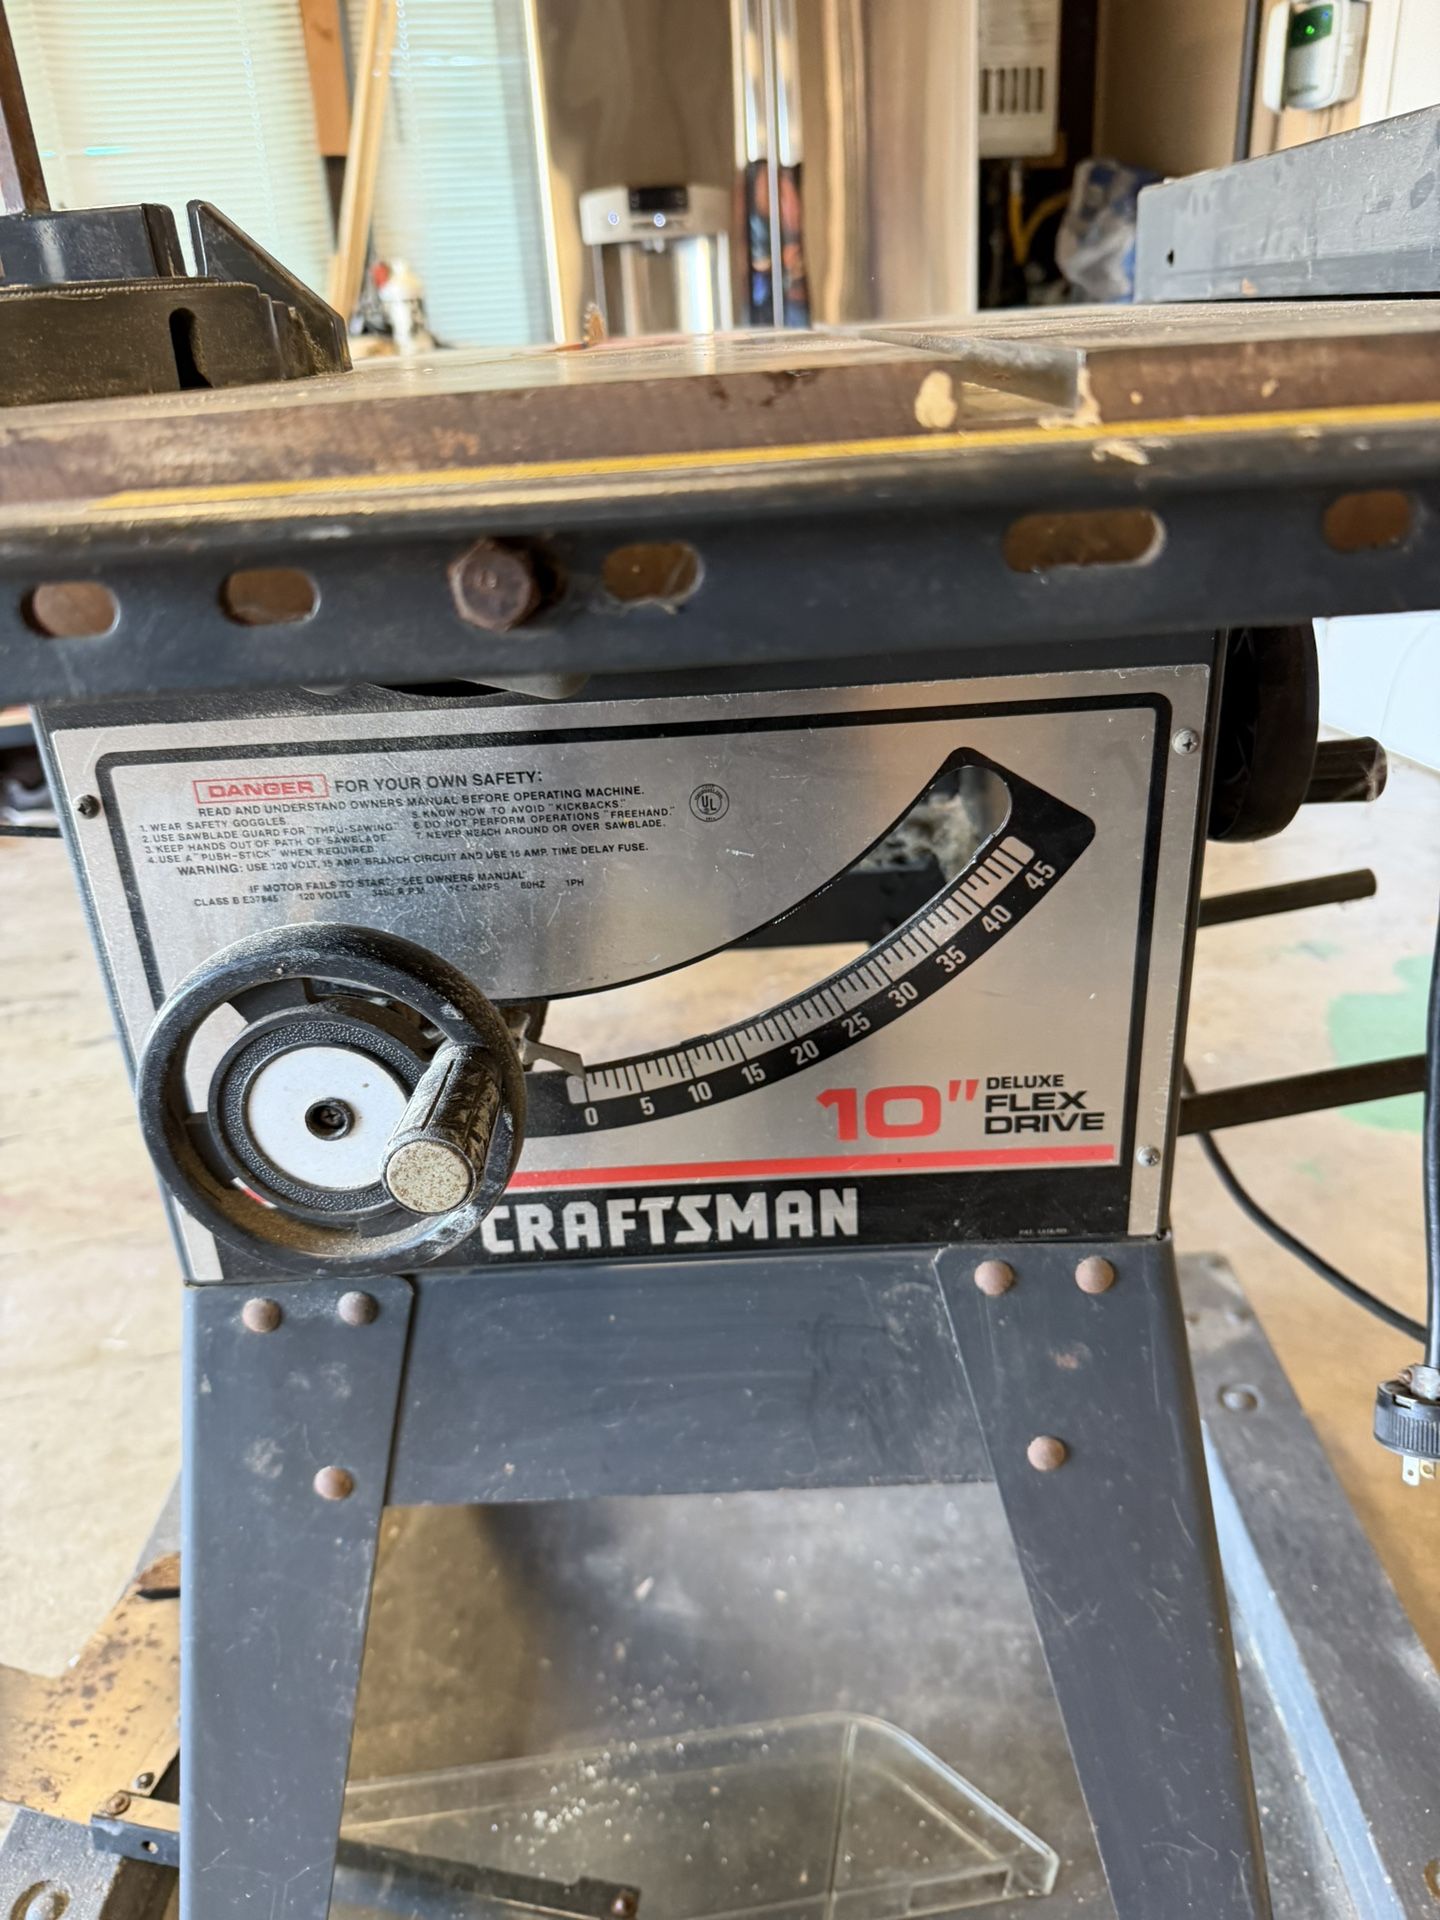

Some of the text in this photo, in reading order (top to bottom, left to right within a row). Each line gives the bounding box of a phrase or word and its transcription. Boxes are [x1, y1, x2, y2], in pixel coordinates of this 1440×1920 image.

[208, 771, 542, 798] DANGER FOR YOUR OWN SAFETY:
[198, 785, 645, 817] READ AND UNDERSTAND OWNERS MANUAL BEFORE OPERATING MACHINE.
[422, 809, 456, 818] KNOW
[491, 806, 505, 815] TO
[511, 804, 545, 814] AVOID
[140, 824, 148, 832] 1.
[150, 822, 182, 832] WEAR
[186, 819, 227, 830] SAFETY
[425, 820, 441, 829] DO
[446, 819, 467, 828] NOT
[473, 816, 526, 826] PERFORM
[531, 812, 599, 824] OPERATIONS
[426, 830, 461, 839] NEVER
[466, 828, 501, 837] REACH
[505, 825, 549, 835] AROUND
[552, 824, 567, 833] OR
[572, 822, 600, 832] OVER
[605, 819, 666, 830] SAWBLADE.
[142, 835, 152, 843] 2.
[152, 833, 174, 843] USE
[178, 830, 239, 841] SAWBLADE
[242, 828, 280, 838] GUARD
[283, 827, 305, 836] FOR
[145, 845, 154, 854] 3.
[155, 844, 184, 853] KEEP
[188, 841, 226, 852] HANDS
[230, 841, 251, 850] OUT
[255, 840, 270, 849] OF
[274, 838, 303, 847] PATH
[307, 837, 321, 846] OF
[159, 854, 181, 864] USE
[186, 854, 193, 862] A
[280, 849, 313, 857] WHEN
[177, 863, 243, 876] WARNING:
[246, 862, 269, 872] USE
[272, 862, 288, 870] 120
[322, 859, 333, 868] 15
[365, 856, 410, 866] BRANCH
[414, 853, 457, 863] CIRCUIT
[460, 851, 483, 860] AND
[486, 850, 508, 859] USE
[524, 849, 548, 857] AMP.
[552, 847, 577, 856] TIME
[581, 844, 614, 854] DELAY
[618, 842, 648, 852] FUSE.
[249, 884, 259, 893] IF
[263, 883, 303, 892] MOTOR
[306, 880, 337, 890] FAILS
[340, 880, 354, 888] TO
[426, 873, 475, 884] OWNERS
[471, 882, 500, 891] AMPS
[521, 880, 546, 889] 60HZ
[565, 879, 584, 887] 1PH
[194, 897, 230, 906] CLASS
[299, 891, 351, 901] 120 VOLTS
[584, 860, 1057, 1126] 0 5 10 15 20 25 30 35 40 45
[986, 1074, 1065, 1090] DELUXE
[816, 1079, 979, 1141] 10"
[985, 1090, 1088, 1113] FLEX
[984, 1112, 1105, 1135] DRIVE
[480, 1188, 859, 1255] CRAFTSMAN
